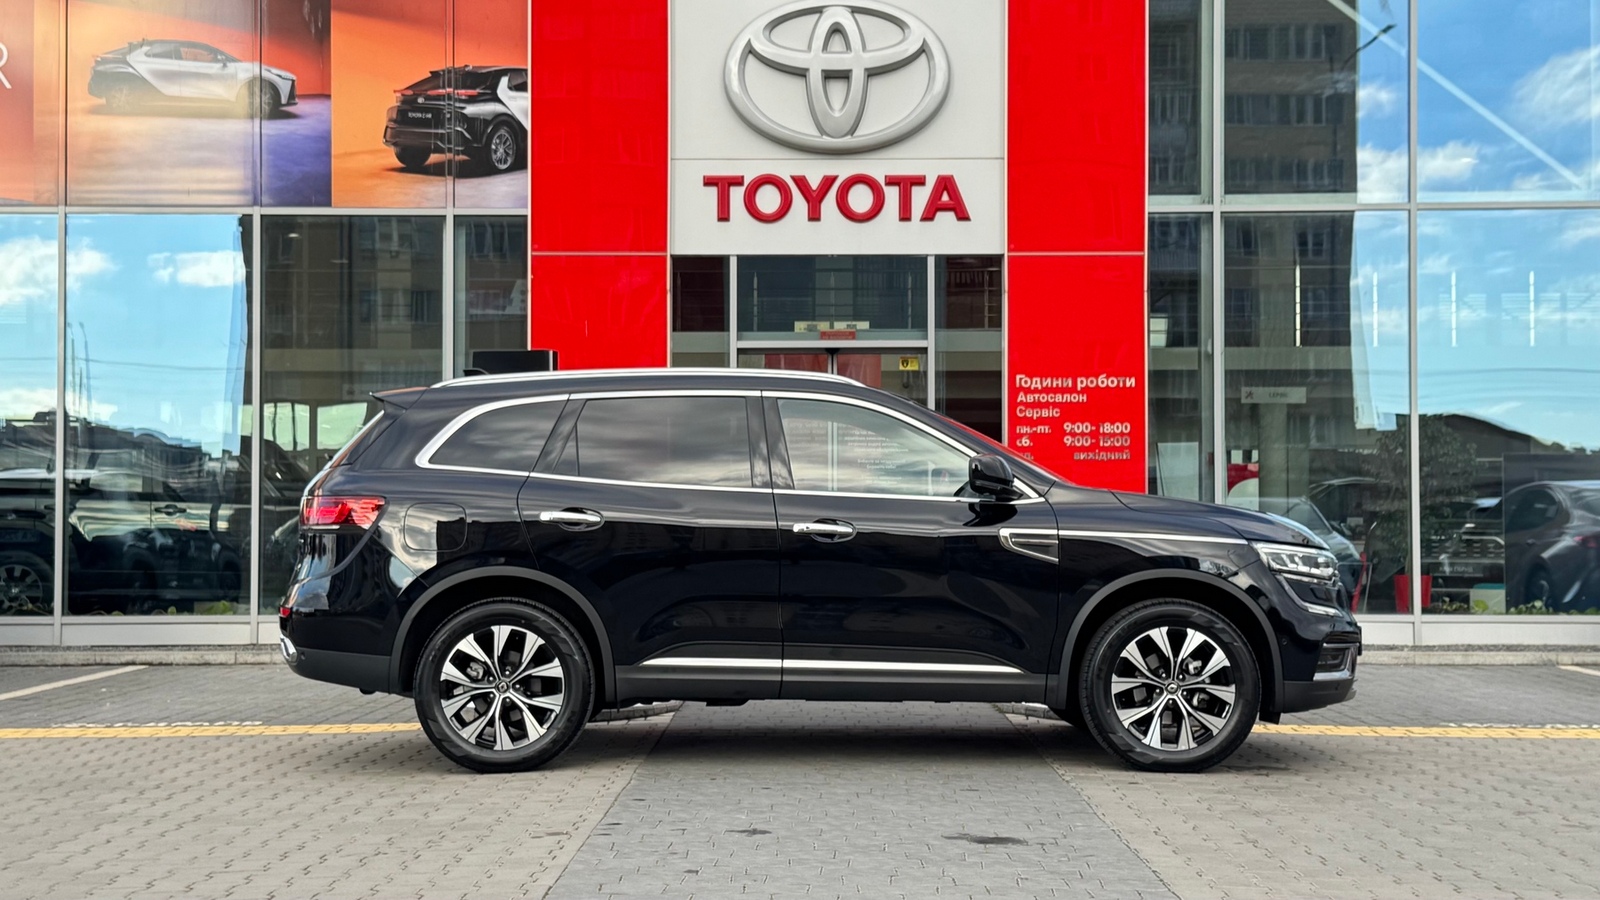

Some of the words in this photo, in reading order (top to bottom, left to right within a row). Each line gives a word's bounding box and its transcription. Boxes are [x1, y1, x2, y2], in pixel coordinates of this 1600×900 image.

[703, 173, 972, 224] TOYOTA
[1016, 374, 1072, 389] Години
[1077, 374, 1135, 390] роботи
[1017, 392, 1086, 402] Автосалон
[1016, 406, 1060, 419] Сервіс
[1016, 436, 1033, 446] сб.
[1073, 449, 1130, 461] вихідний
